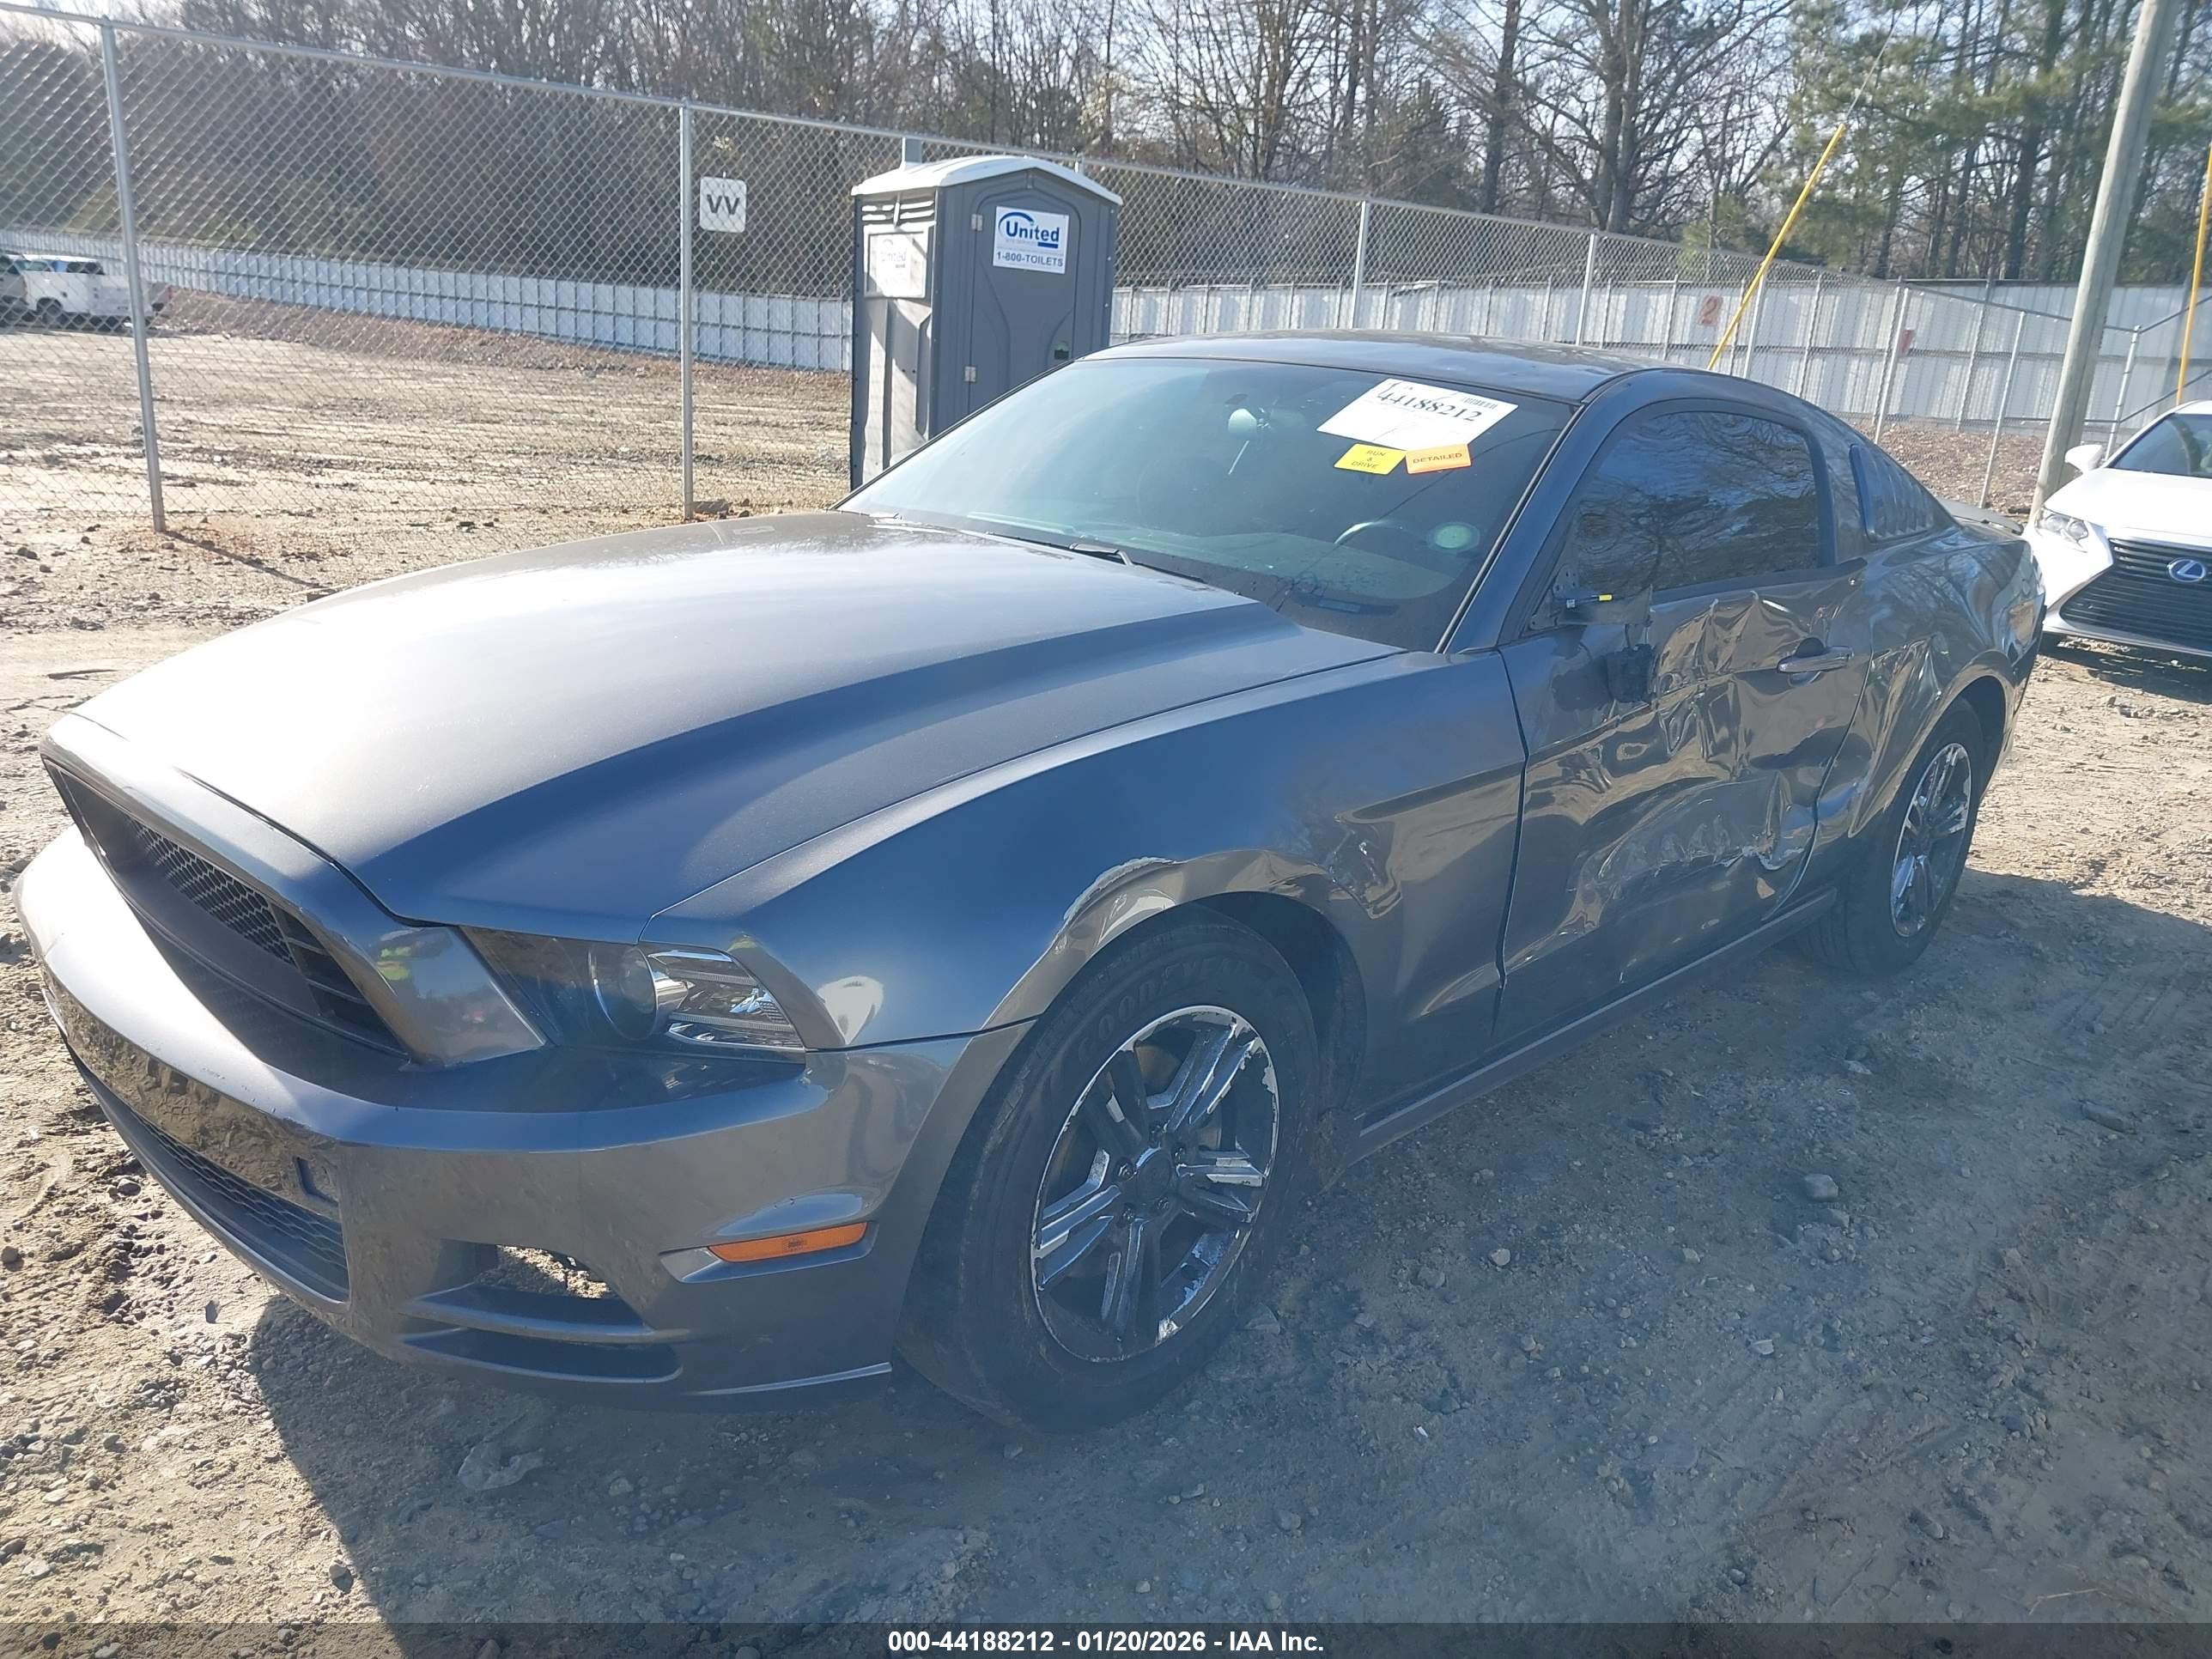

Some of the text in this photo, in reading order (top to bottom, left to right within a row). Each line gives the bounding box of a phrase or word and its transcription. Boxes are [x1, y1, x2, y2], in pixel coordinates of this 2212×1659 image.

[1006, 220, 1060, 242] United
[997, 251, 1064, 268] 1-800-TOILETS
[1377, 383, 1482, 421] 44188212
[1351, 460, 1379, 470] DRIVE
[1413, 453, 1462, 465] DETAILED
